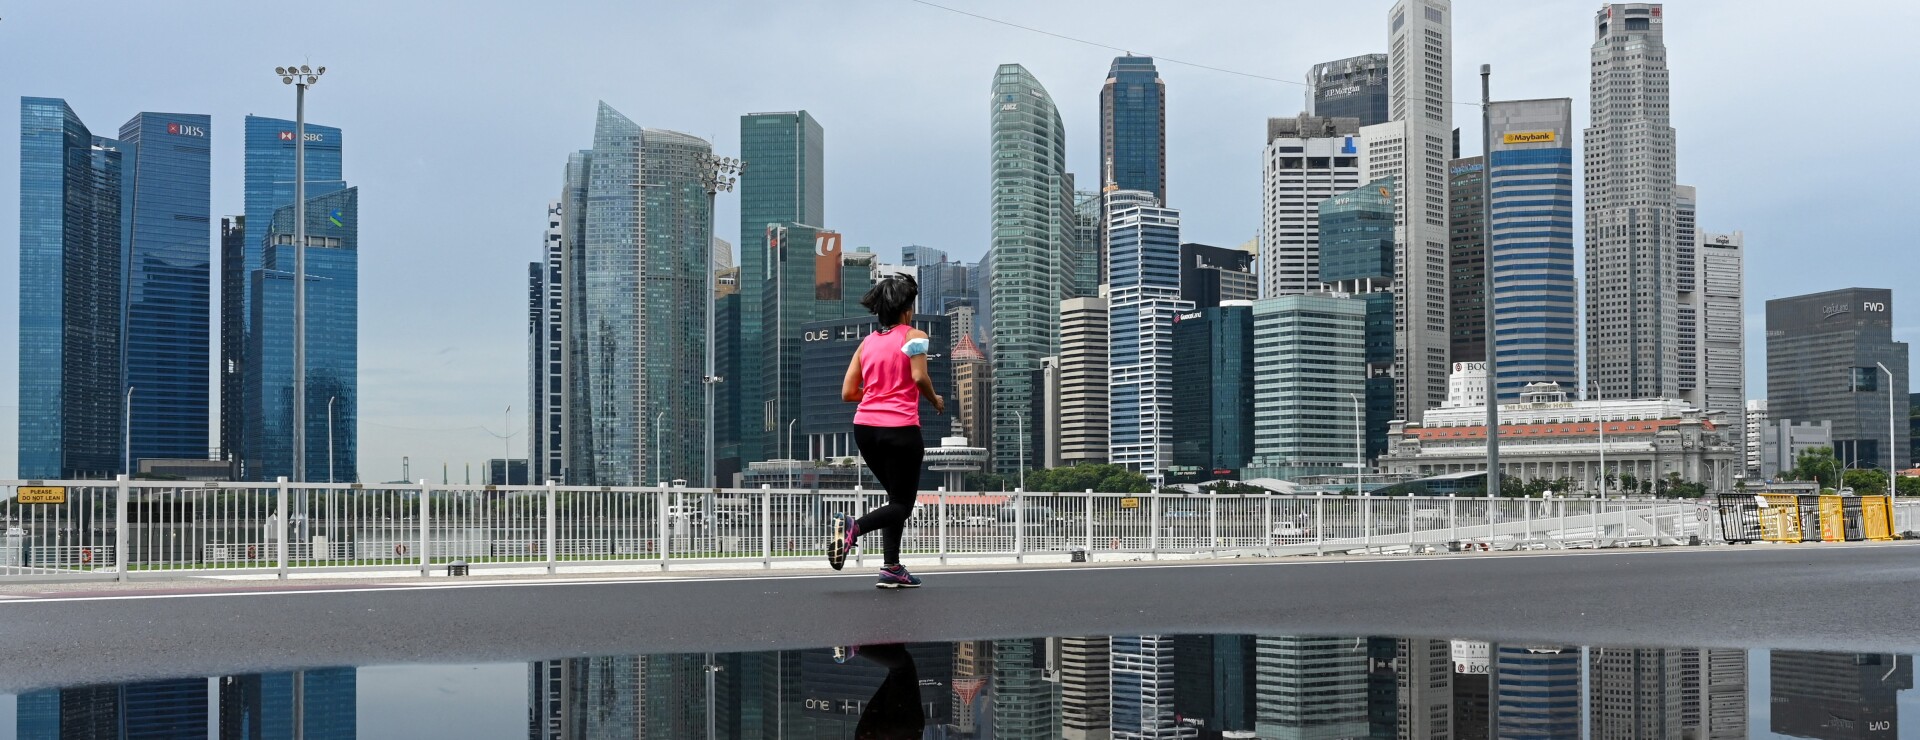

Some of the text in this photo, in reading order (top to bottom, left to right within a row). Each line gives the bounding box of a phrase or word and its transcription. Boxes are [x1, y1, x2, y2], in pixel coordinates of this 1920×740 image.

[179, 124, 204, 137] DBS
[303, 133, 323, 142] SBC
[1514, 133, 1550, 141] Maybank
[1863, 302, 1885, 312] FWD
[804, 330, 829, 342] OUE
